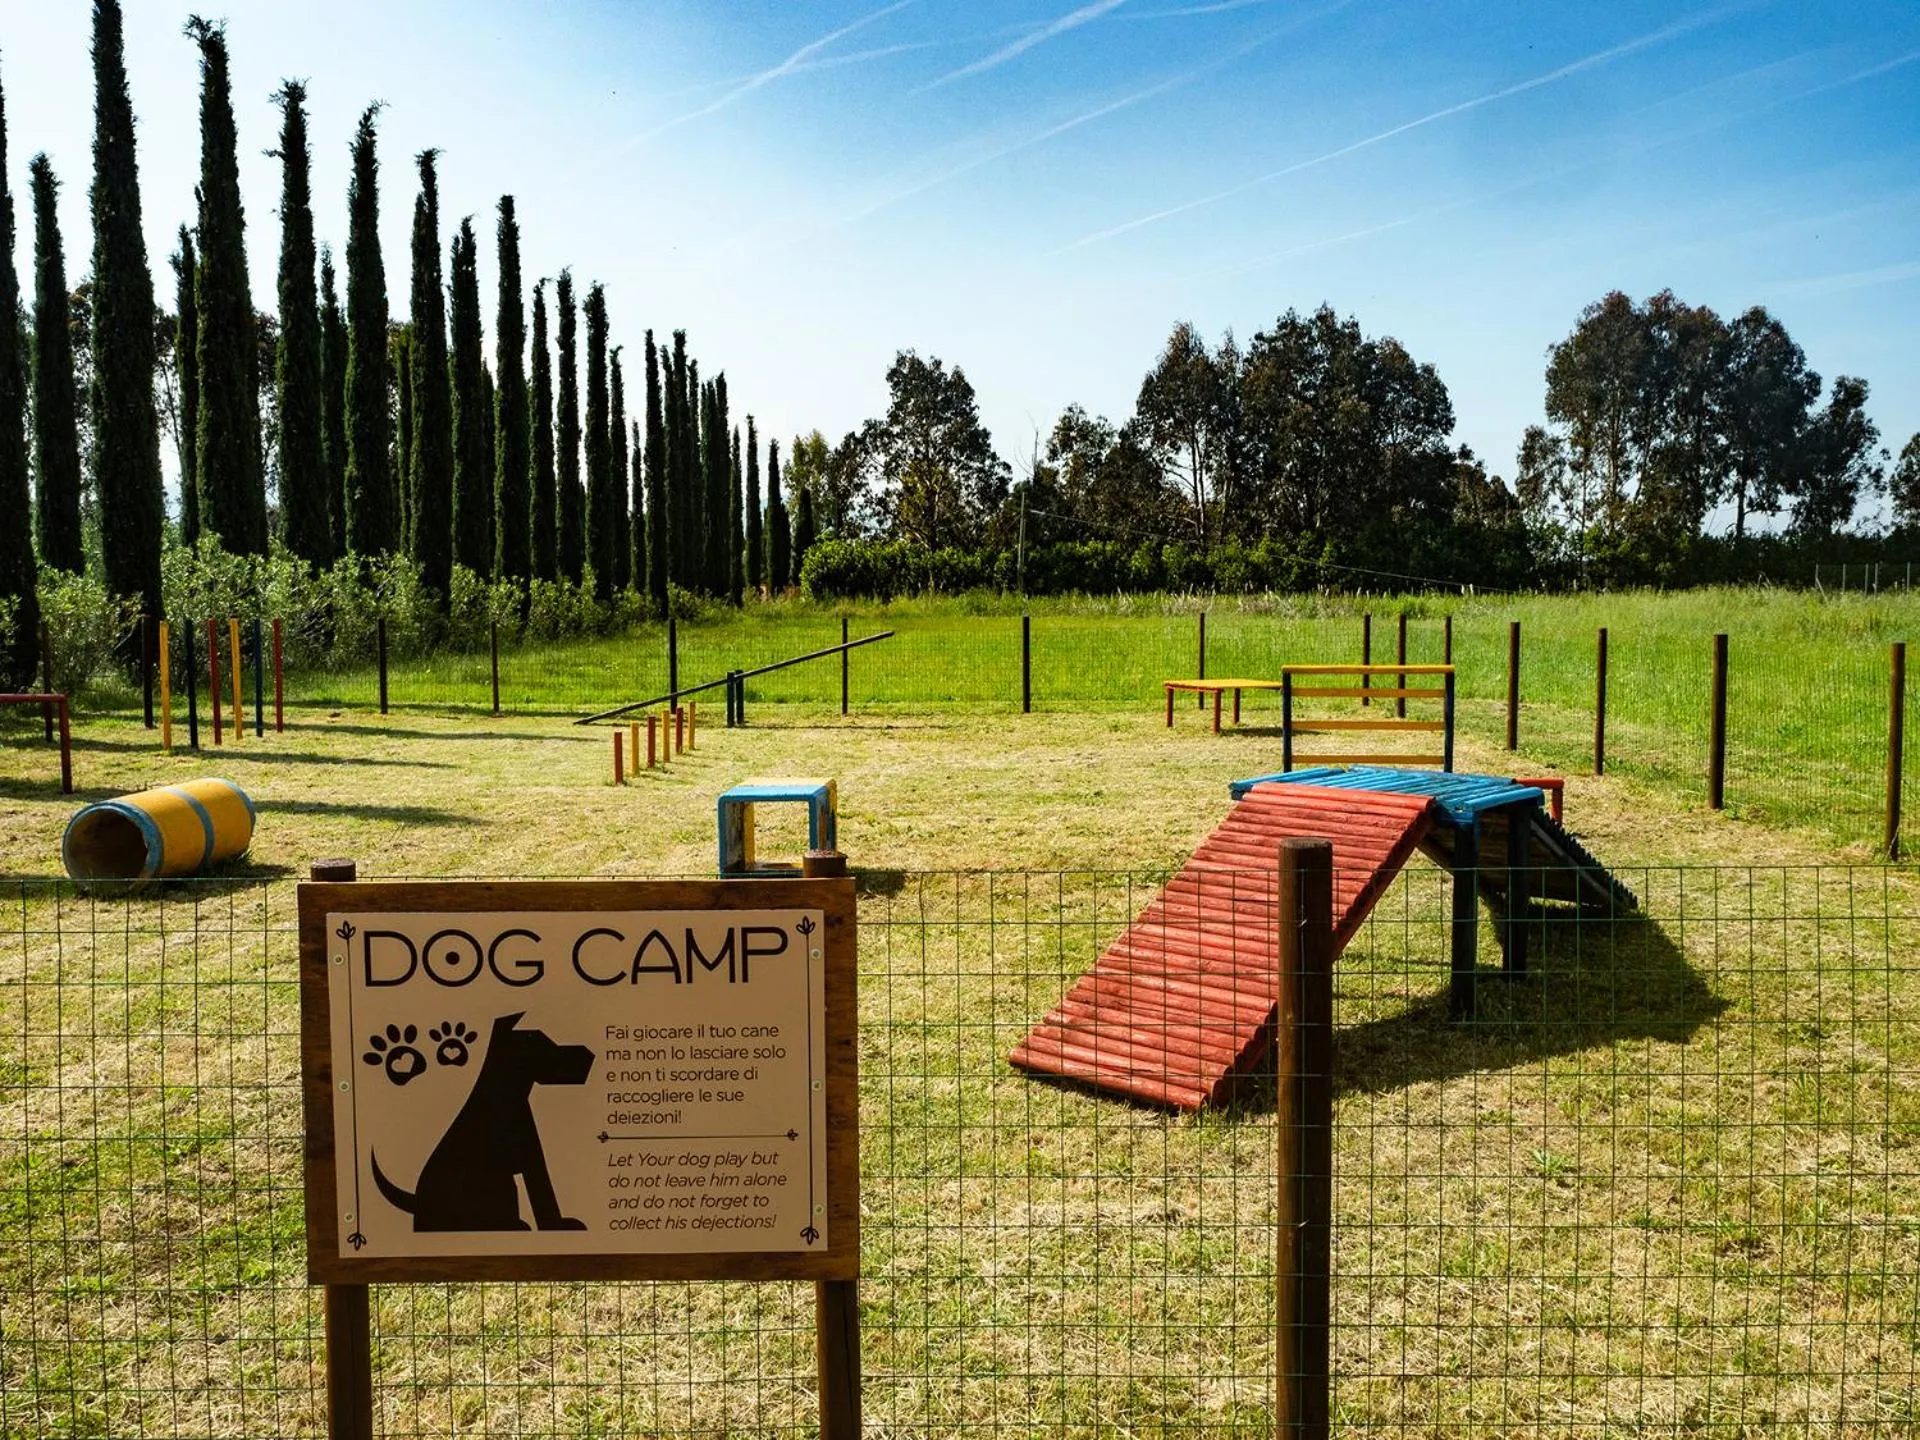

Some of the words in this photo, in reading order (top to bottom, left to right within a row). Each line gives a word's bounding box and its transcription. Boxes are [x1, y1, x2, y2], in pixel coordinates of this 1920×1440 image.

[363, 929, 544, 987] DOG
[572, 926, 789, 988] CAMP
[605, 1025, 629, 1040] Fai
[633, 1025, 694, 1042] giocare
[697, 1024, 705, 1038] il
[709, 1025, 737, 1038] tuo
[740, 1025, 780, 1038] cane
[606, 1049, 631, 1061] ma
[636, 1048, 666, 1060] non
[671, 1046, 686, 1060] lo
[690, 1045, 749, 1060] lasciare
[753, 1045, 787, 1059] solo
[606, 1071, 616, 1082] e
[620, 1070, 651, 1082] non
[655, 1067, 666, 1081] ti
[670, 1066, 740, 1081] scordare
[743, 1066, 759, 1080] di
[607, 1088, 694, 1105] raccogliere
[699, 1089, 713, 1102] le
[716, 1090, 745, 1102] sue
[607, 1109, 683, 1125] deiezioni!
[608, 1153, 634, 1167] Let
[638, 1152, 676, 1167] Your
[678, 1152, 711, 1168] dog
[713, 1151, 748, 1168] play
[751, 1151, 779, 1166] but
[608, 1174, 630, 1188] do
[633, 1175, 662, 1188] not
[665, 1173, 706, 1188] leave
[709, 1173, 740, 1187] him
[743, 1172, 788, 1187] alone
[608, 1195, 640, 1209] and
[643, 1194, 665, 1209] do
[668, 1195, 696, 1208] not
[700, 1193, 750, 1210] forget
[752, 1195, 770, 1208] to
[609, 1216, 661, 1231] collect
[665, 1216, 688, 1230] his
[691, 1214, 778, 1232] dejections!
